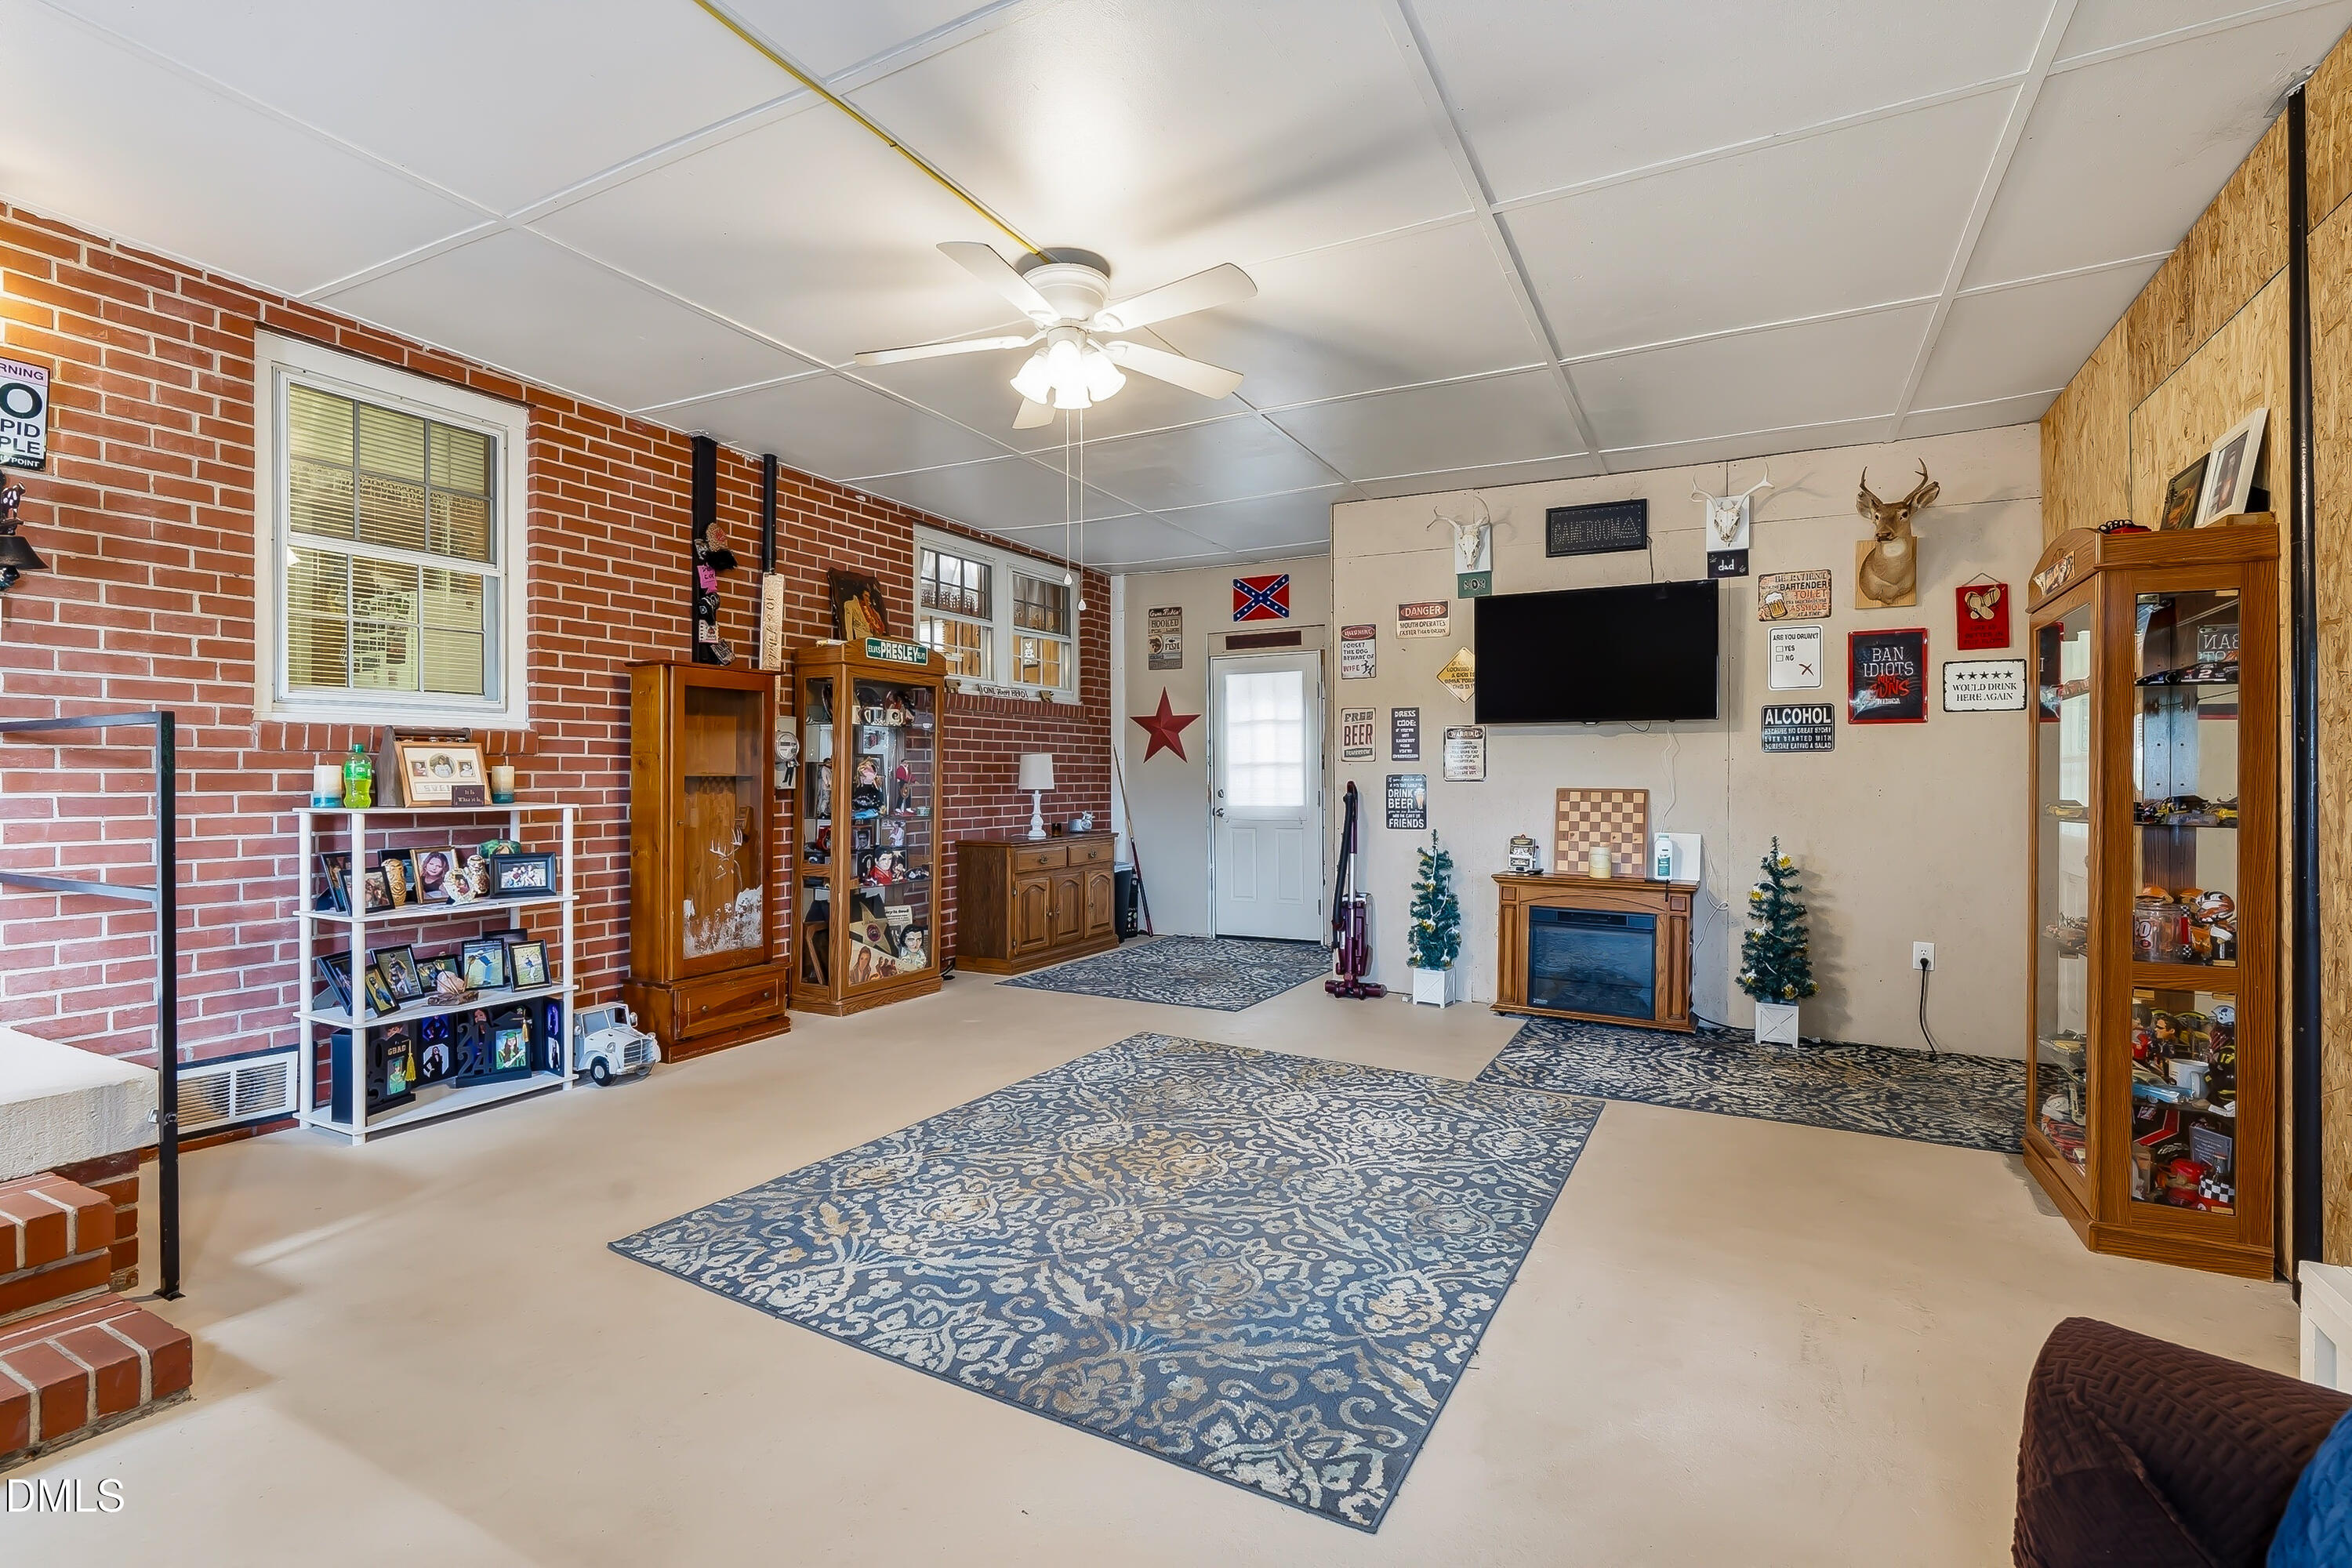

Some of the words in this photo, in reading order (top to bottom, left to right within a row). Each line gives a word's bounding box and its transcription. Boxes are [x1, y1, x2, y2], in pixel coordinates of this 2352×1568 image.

[11, 457, 40, 467] POINT
[1718, 558, 1734, 571] dad
[1780, 580, 1827, 591] BARTENDER
[1405, 605, 1442, 618] DANGER
[1789, 603, 1827, 612] ASSHOLE
[1151, 618, 1179, 629] HOOKED
[880, 641, 919, 662] PRESLEY
[1871, 647, 1904, 662] BAN
[1343, 664, 1360, 673] WIFE
[1863, 662, 1914, 677] IDIOTS
[1952, 683, 1987, 692] WOULD
[1987, 681, 2017, 691] DRINK
[1956, 693, 1983, 702] HERE
[1984, 691, 2014, 702] AGAIN
[1345, 711, 1374, 722] FREE
[1764, 707, 1832, 725] ALCOHOL
[1344, 723, 1374, 746] BEER
[1388, 788, 1414, 798] DRINK
[1388, 798, 1414, 809] BEER
[1388, 818, 1425, 828] FRIENDS
[387, 1044, 406, 1056] GRAD
